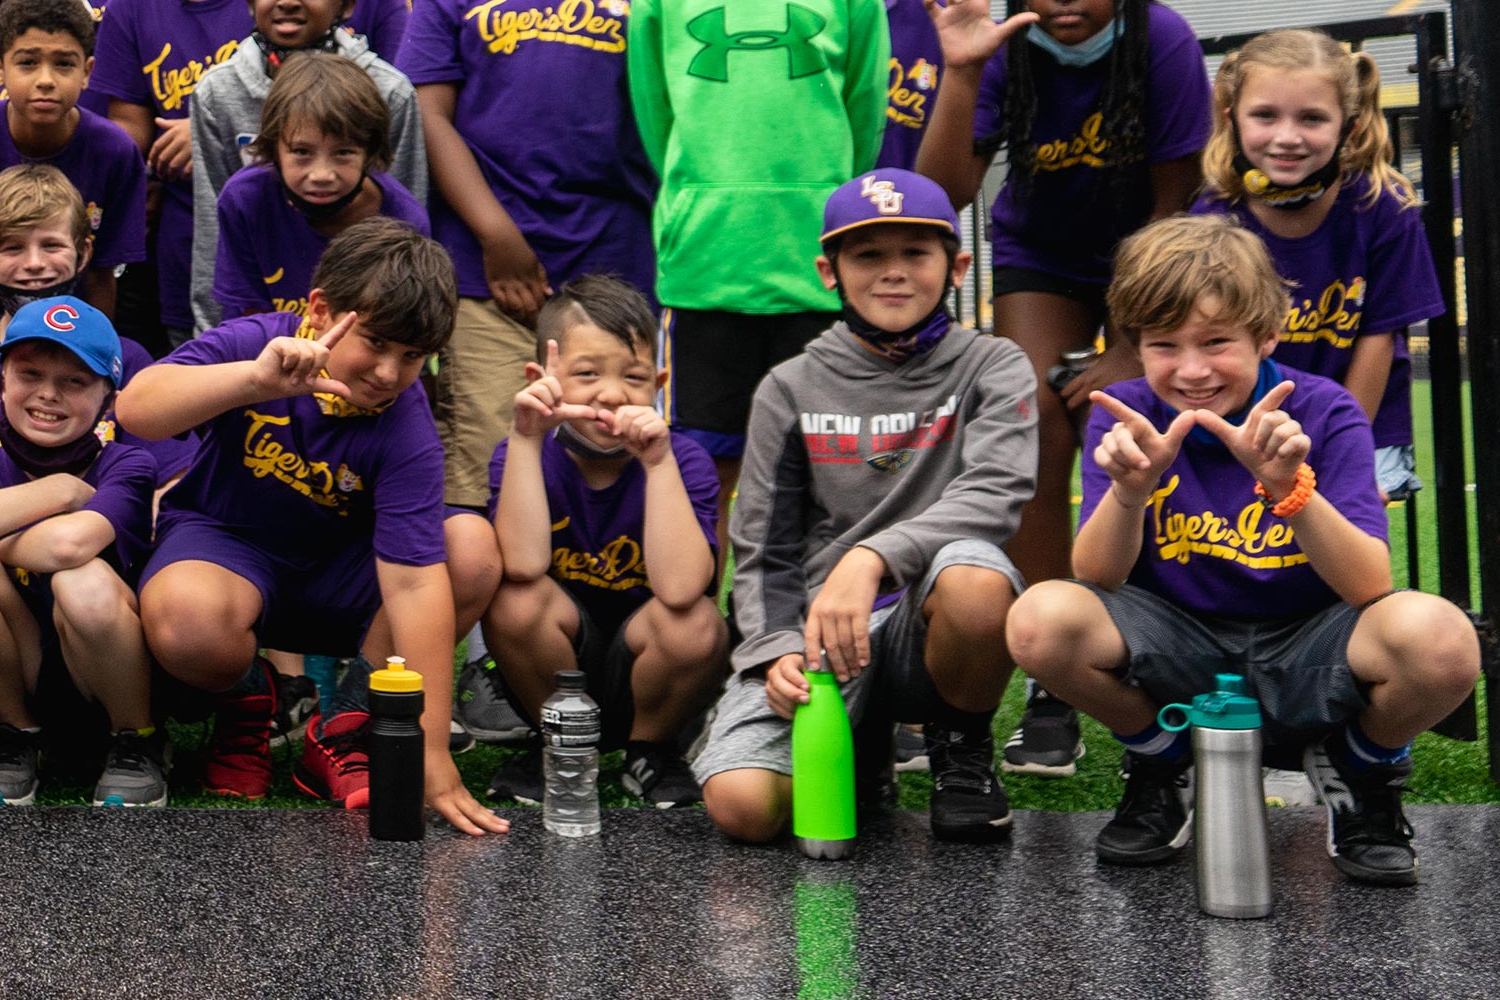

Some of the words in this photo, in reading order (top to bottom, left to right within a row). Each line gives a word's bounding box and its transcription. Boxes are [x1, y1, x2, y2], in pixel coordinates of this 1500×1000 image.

[142, 43, 212, 111] Tiger'
[860, 173, 905, 216] LSU
[43, 304, 80, 332] C
